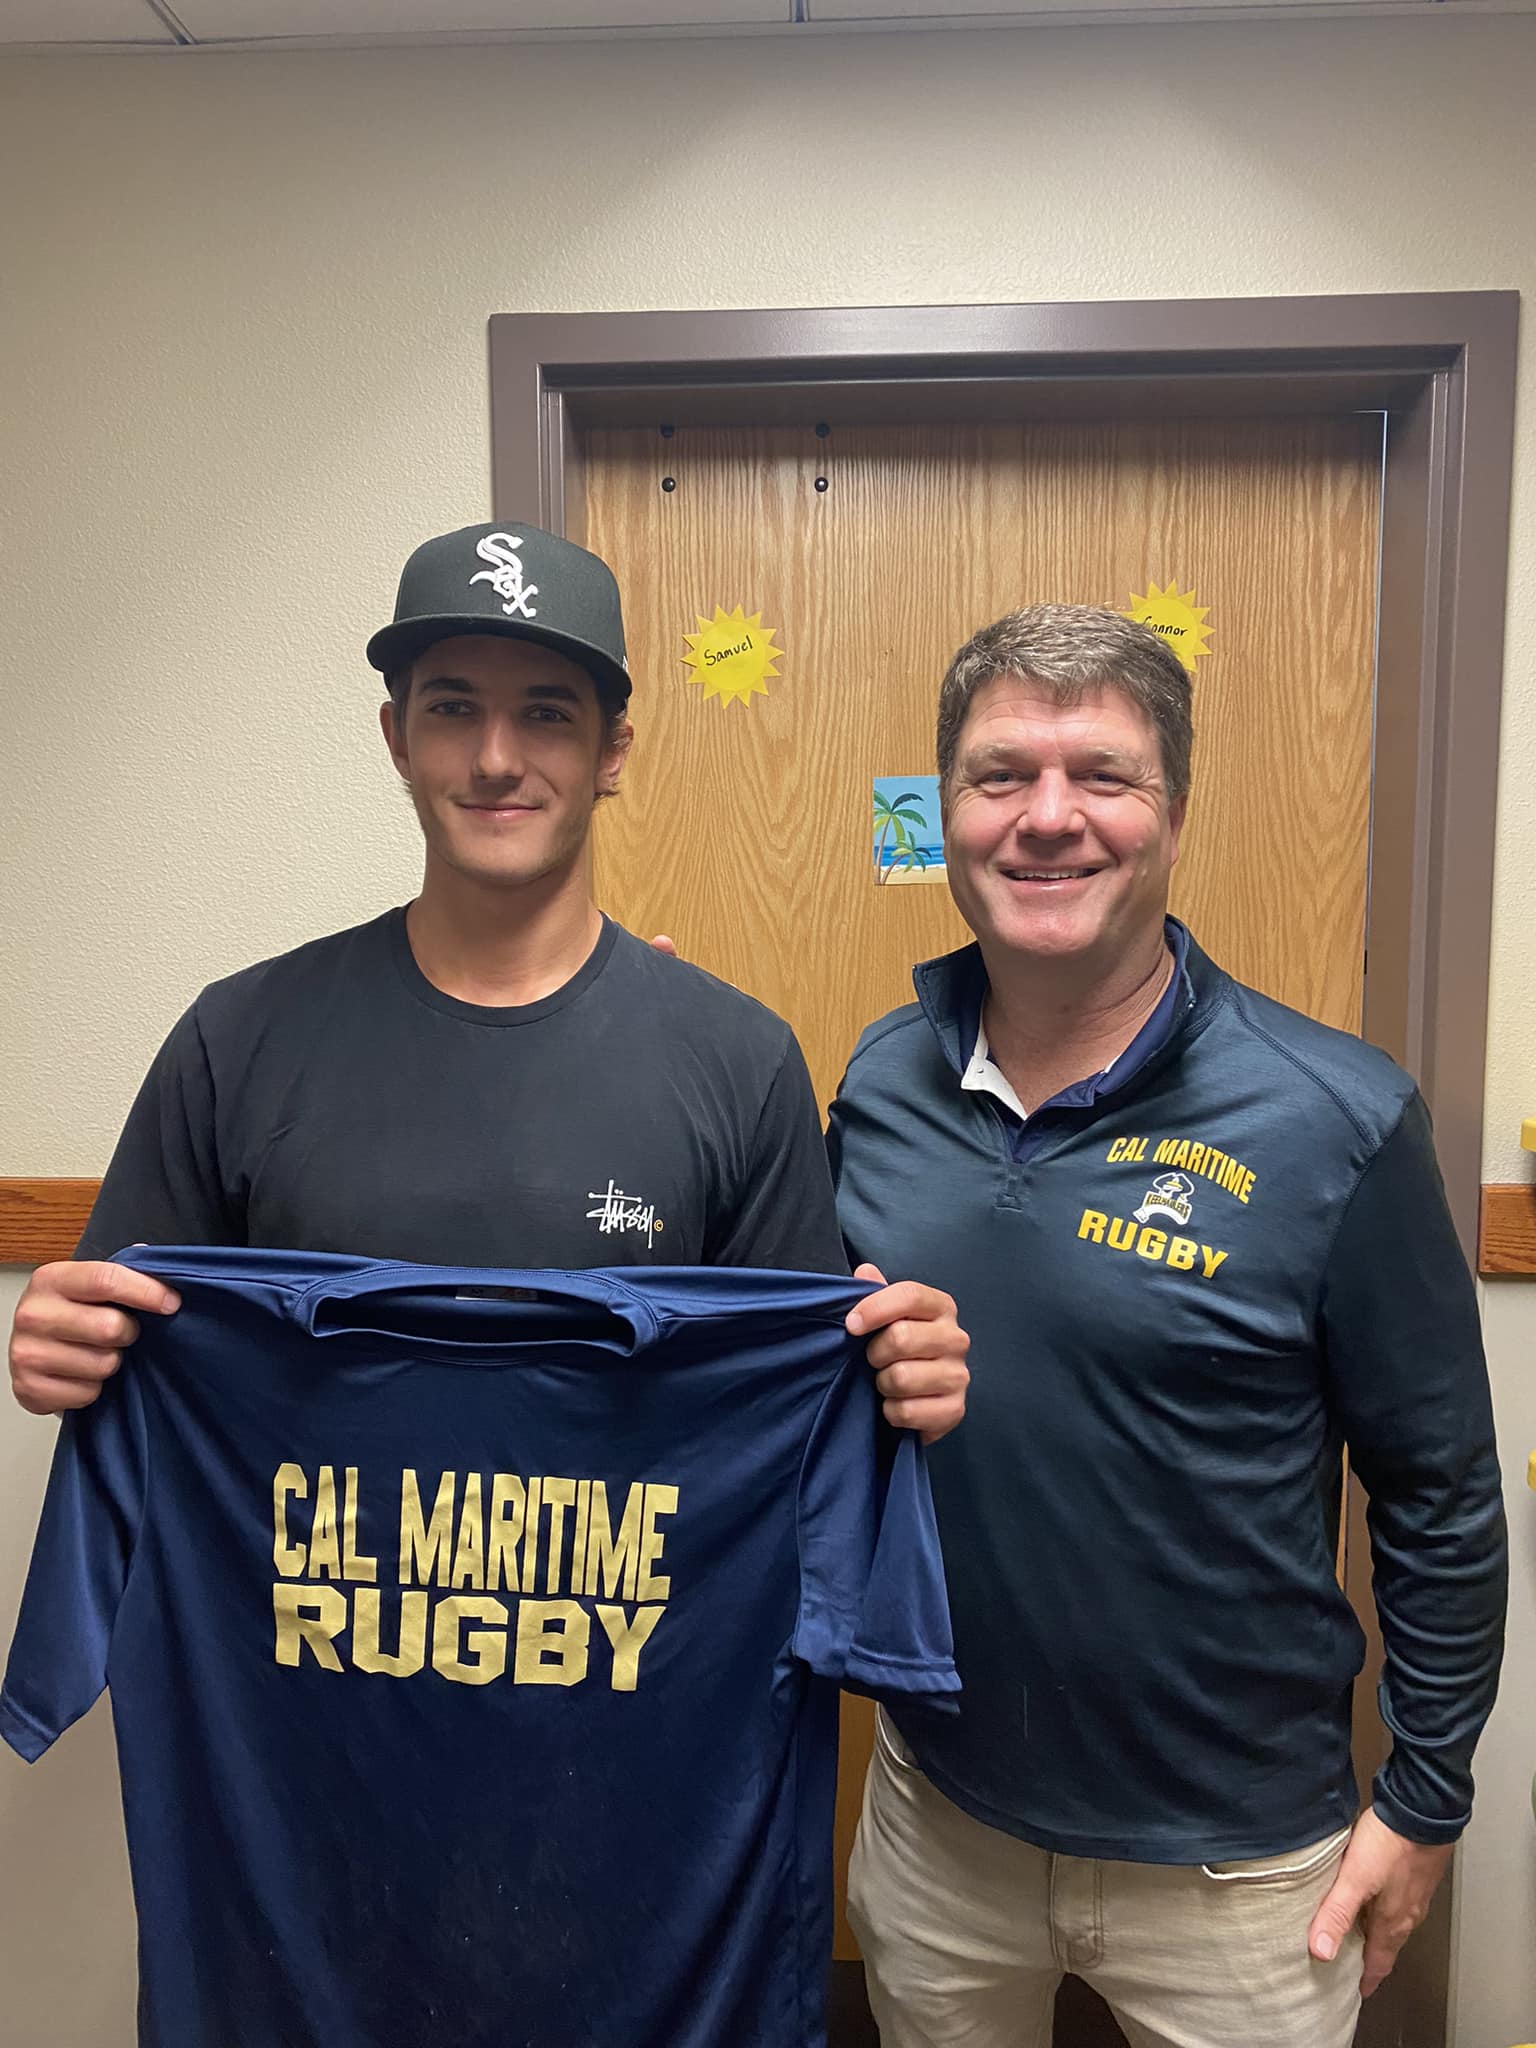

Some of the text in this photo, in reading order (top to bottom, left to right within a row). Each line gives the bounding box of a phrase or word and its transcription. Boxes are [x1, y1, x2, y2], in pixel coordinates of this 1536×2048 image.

[468, 532, 539, 618] Sox
[704, 634, 753, 666] Samuel
[1106, 1137, 1257, 1204] CAL MARITIME
[1077, 1209, 1228, 1278] RUGBY
[273, 1462, 679, 1601] CAL MARITIME
[273, 1582, 667, 1692] RUGBY
